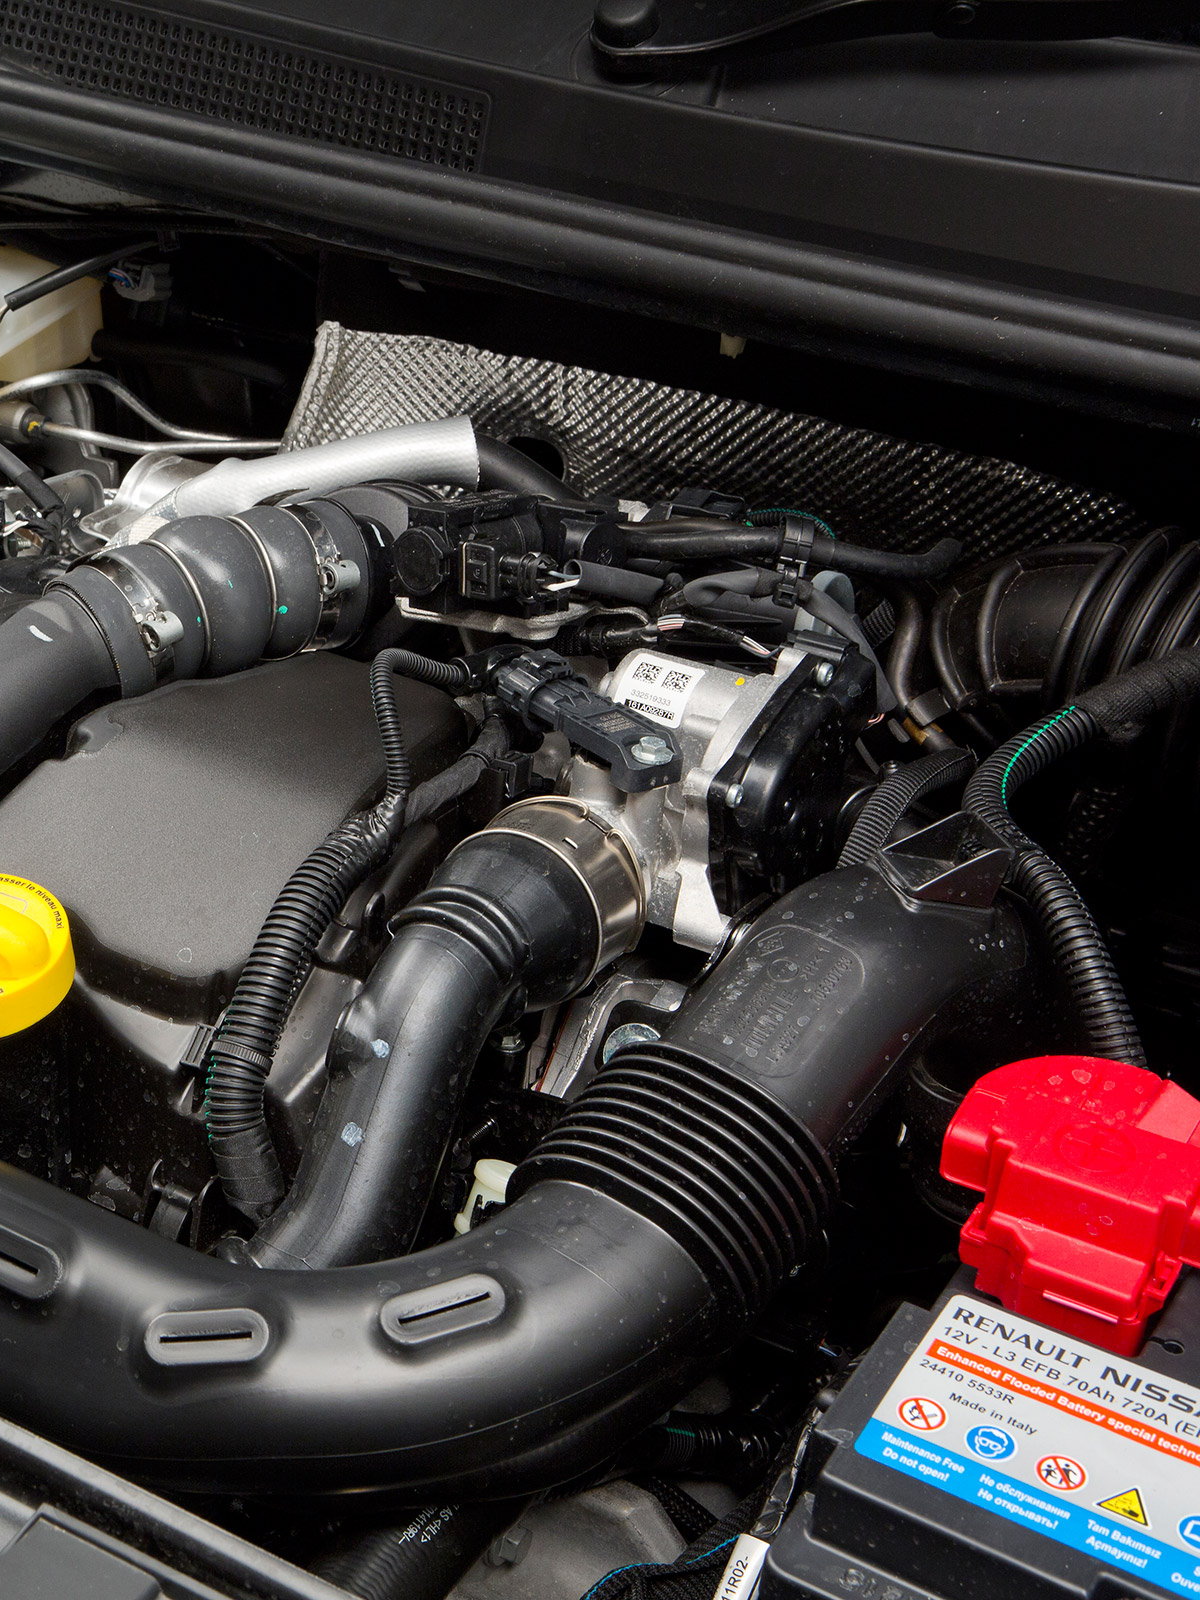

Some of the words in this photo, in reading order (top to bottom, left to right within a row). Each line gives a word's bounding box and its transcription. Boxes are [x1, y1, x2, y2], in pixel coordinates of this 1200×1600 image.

[631, 689, 672, 706] 332519333
[26, 882, 36, 891] le
[35, 888, 57, 914] niveau
[53, 910, 65, 930] maxi
[920, 1358, 964, 1382] 24410
[967, 1379, 1015, 1405] 5533R
[944, 1326, 978, 1345] 12V
[993, 1346, 1017, 1362] L3
[1021, 1357, 1061, 1380] EFB
[1067, 1375, 1115, 1402] 70Ah
[1122, 1397, 1168, 1425] 720A
[952, 1306, 1091, 1369] RENAULT
[1100, 1366, 1200, 1418] NISS
[936, 1346, 1002, 1379] Enhanced
[1002, 1372, 1056, 1401] Flooded
[1056, 1395, 1106, 1422] Battery
[1107, 1417, 1157, 1443] special
[949, 1392, 988, 1414] Made
[990, 1409, 1003, 1421] in
[1006, 1416, 1038, 1436] Italy
[881, 1431, 942, 1464] Maintenance
[942, 1456, 966, 1474] Free
[882, 1447, 898, 1460] Do
[899, 1455, 918, 1469] not
[918, 1464, 950, 1482] open!
[977, 1488, 994, 1502] Не
[994, 1496, 1059, 1530] открывать!
[979, 1473, 995, 1488] Не
[996, 1481, 1072, 1520] обслуживания
[1085, 1536, 1148, 1568] Açmayınız!
[1088, 1518, 1110, 1537] Tam
[1111, 1530, 1162, 1560] Bakımsız
